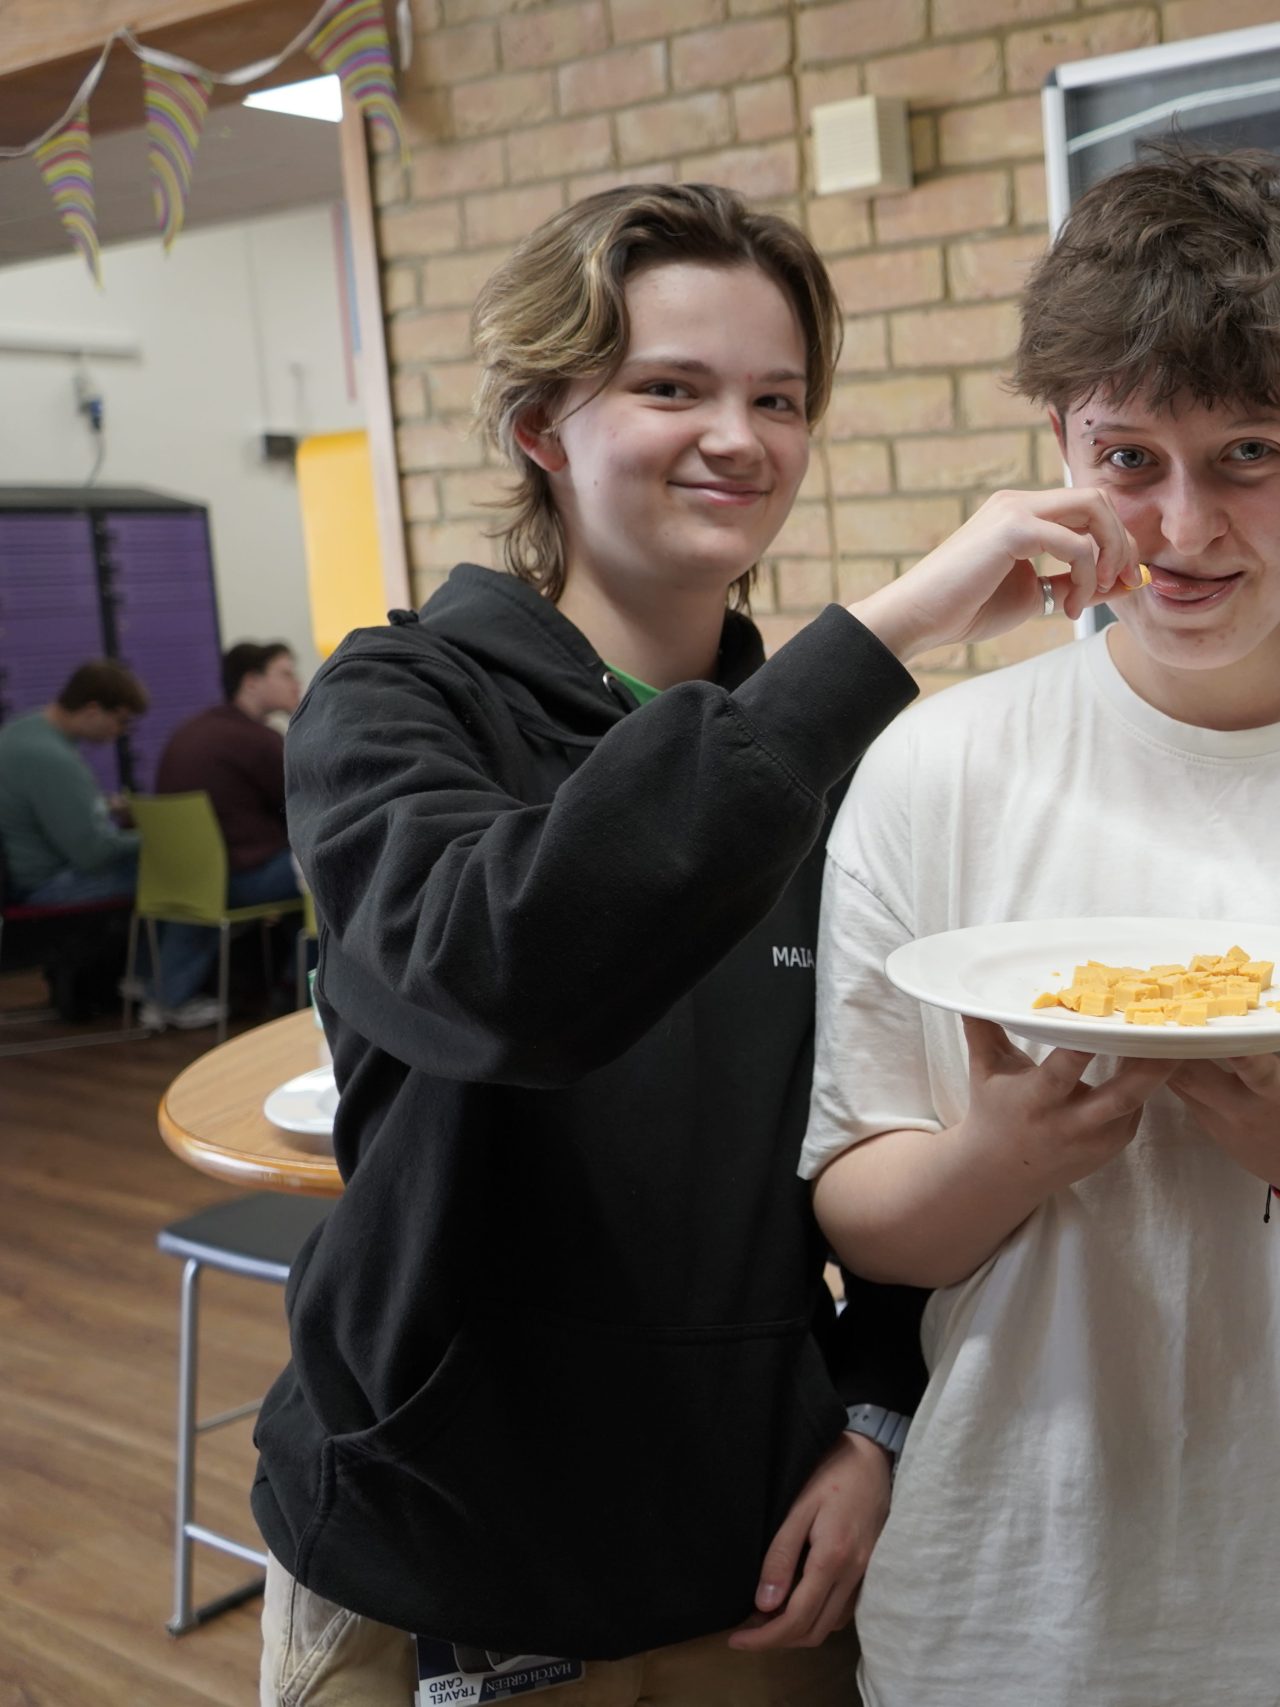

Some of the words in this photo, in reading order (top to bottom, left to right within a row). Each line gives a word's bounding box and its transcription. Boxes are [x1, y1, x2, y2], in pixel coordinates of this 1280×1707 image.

[531, 1663, 572, 1681] HATCH
[429, 1676, 463, 1693] CARD
[486, 1675, 528, 1692] GREEN
[430, 1686, 477, 1704] TRAVEL
